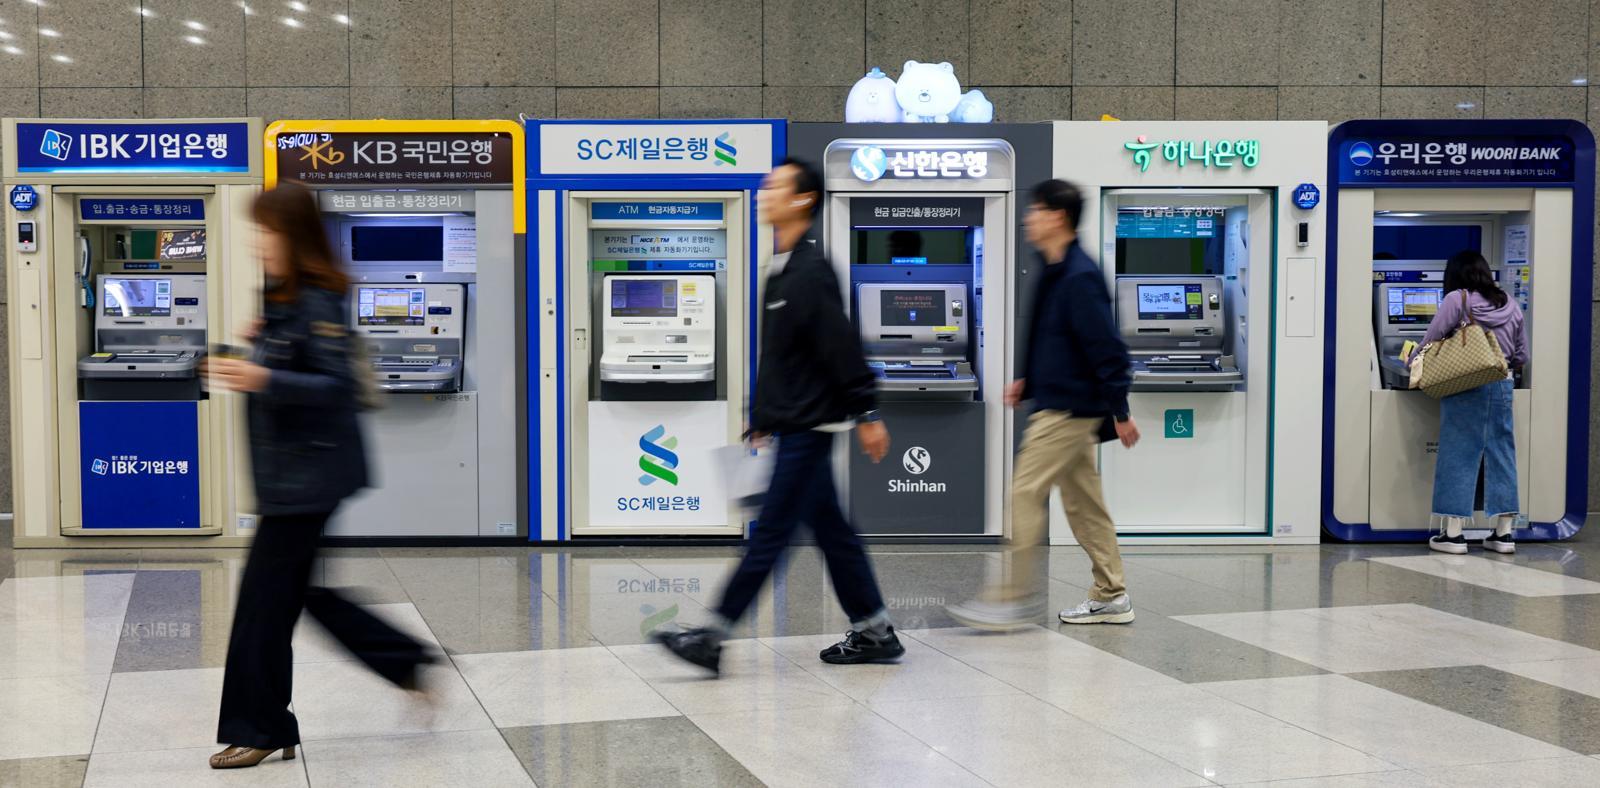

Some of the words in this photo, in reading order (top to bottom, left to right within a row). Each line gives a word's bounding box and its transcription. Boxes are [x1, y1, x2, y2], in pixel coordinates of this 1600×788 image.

[353, 139, 493, 165] KB국민은행
[576, 137, 708, 160] SC제일은행
[1162, 139, 1260, 168] 하나은행
[1375, 142, 1467, 165] 우리은행
[1471, 146, 1517, 160] WOORI
[1519, 147, 1561, 160] BANK
[890, 150, 988, 178] 신한은행
[14, 193, 32, 203] ADT
[332, 194, 356, 208] 현금
[360, 194, 462, 208] 입출금·통장정리기
[1298, 192, 1317, 202] ADT
[618, 205, 639, 214] ATM
[648, 205, 698, 215] 현금자동지급기
[874, 206, 889, 218] 현금
[604, 235, 628, 244] 본기기는
[677, 235, 689, 244] 에서
[691, 236, 715, 244] 운영하는
[607, 246, 641, 254] SC제일은행
[650, 246, 661, 254] 제휴
[111, 460, 189, 474] IBK기업은행
[887, 479, 946, 492] Shinhan
[616, 495, 700, 511] SC제일은행
